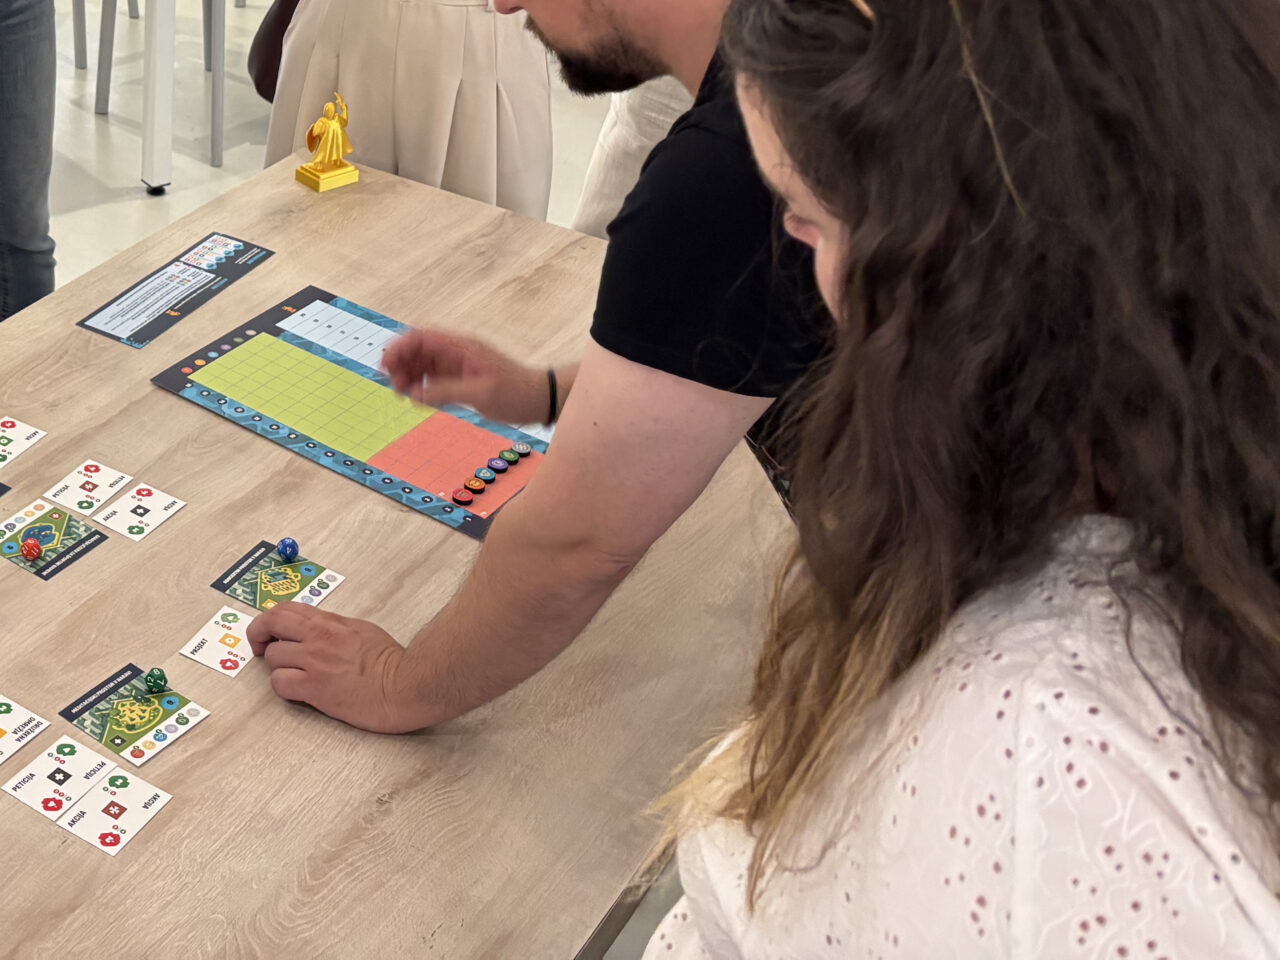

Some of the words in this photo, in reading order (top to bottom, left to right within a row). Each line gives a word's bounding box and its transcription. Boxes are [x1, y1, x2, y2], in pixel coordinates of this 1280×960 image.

[82, 761, 107, 781] PETICIJA
[11, 772, 37, 792] PETICIJA
[141, 792, 161, 810] AKCIJA
[67, 809, 87, 828] AKCIJA
